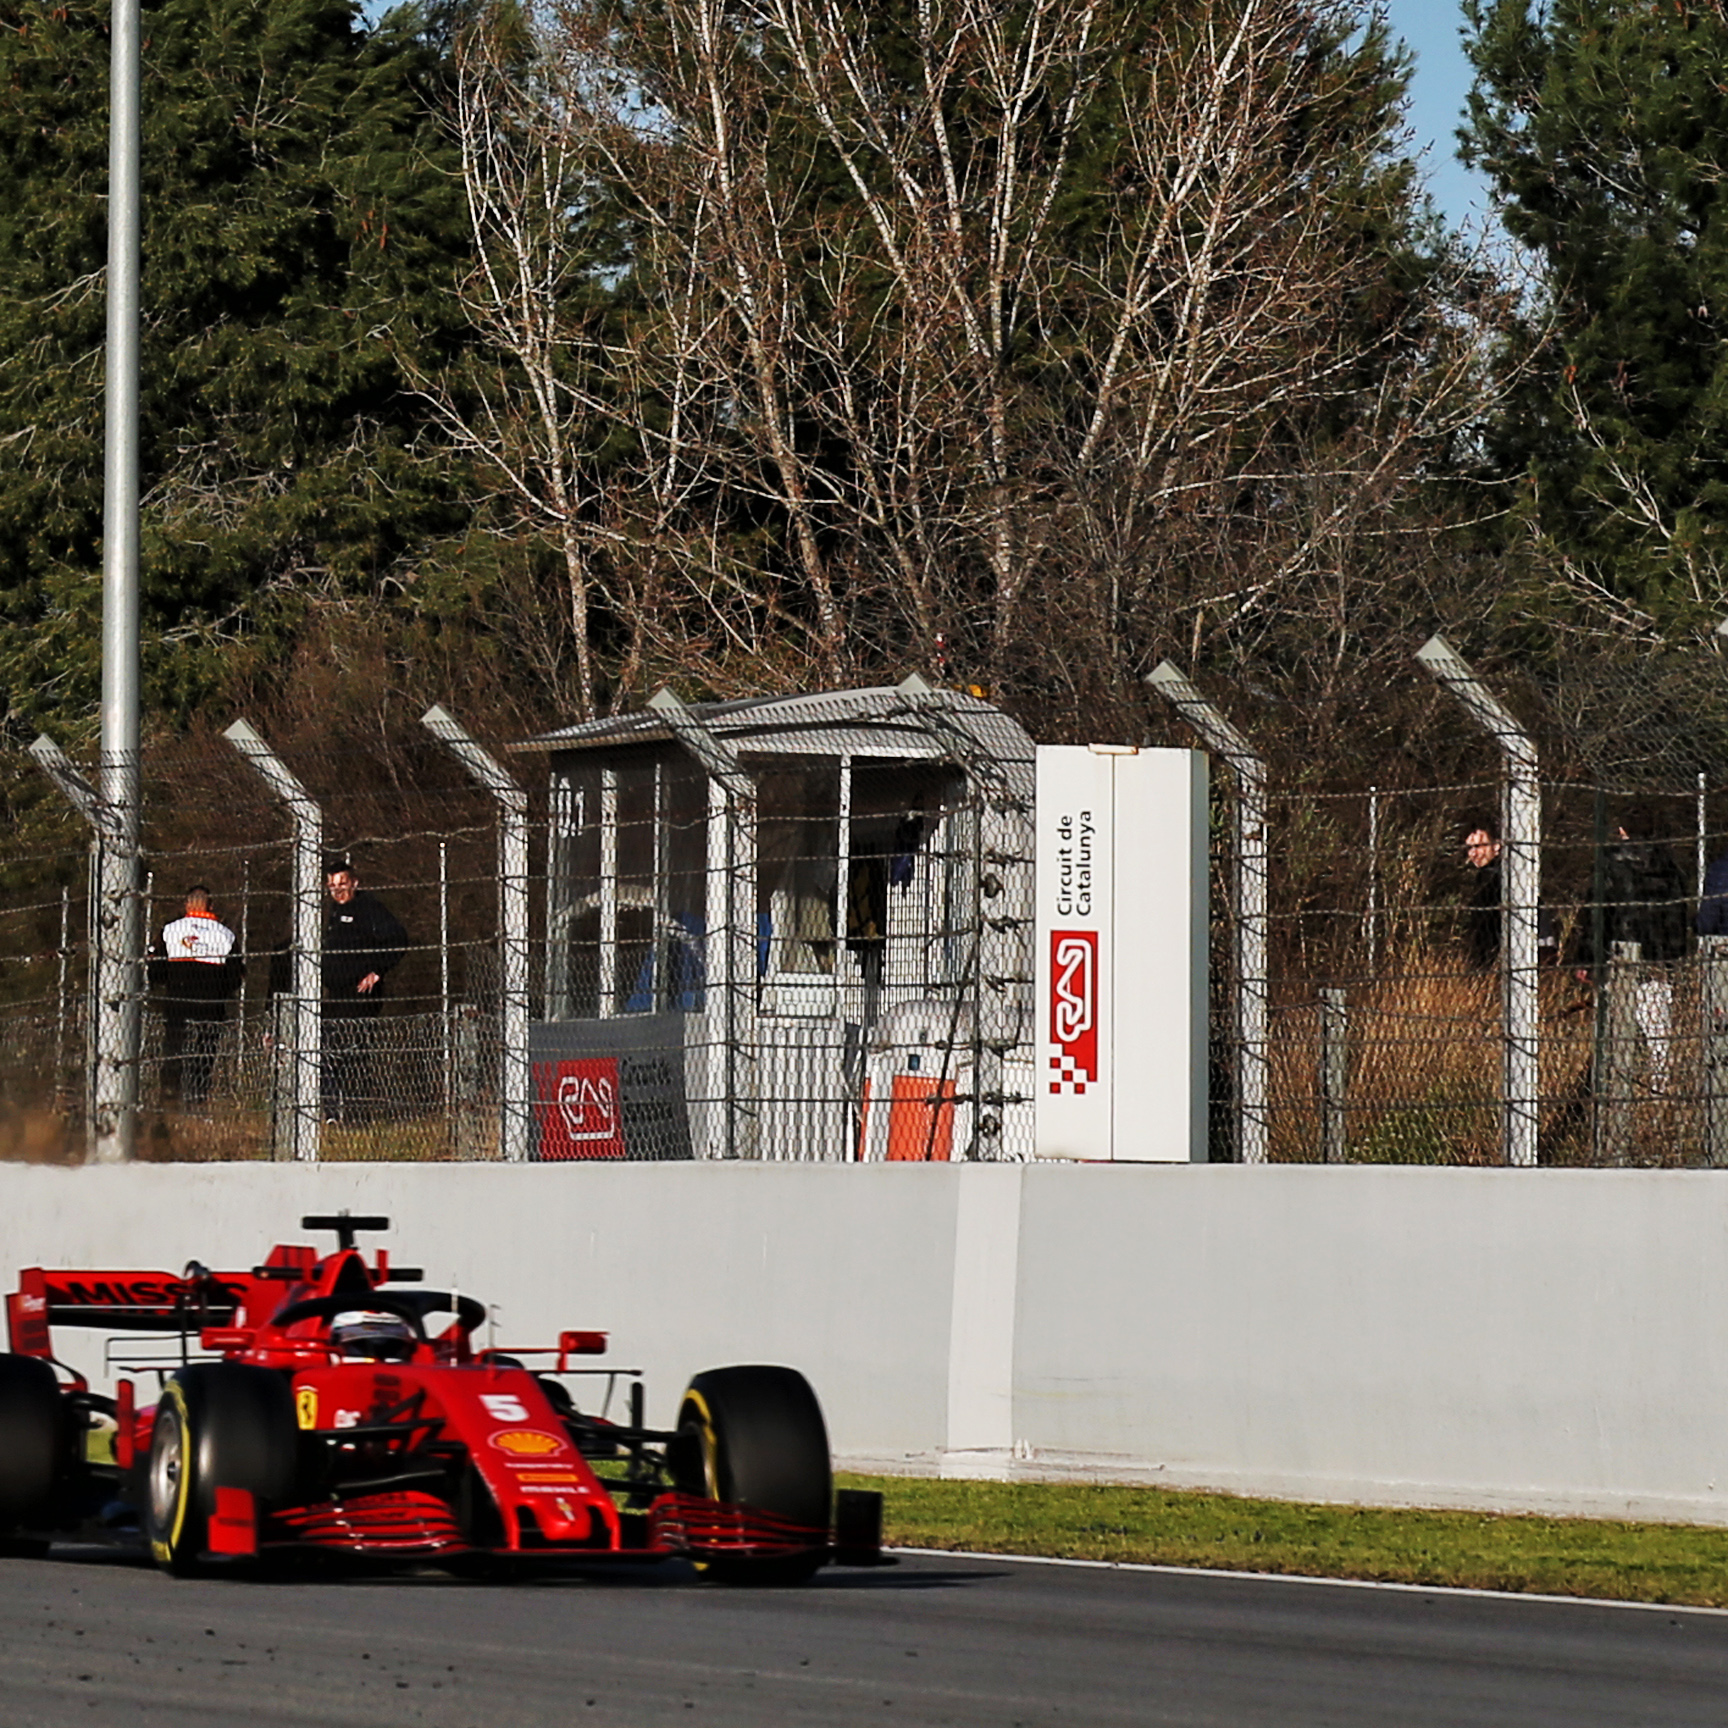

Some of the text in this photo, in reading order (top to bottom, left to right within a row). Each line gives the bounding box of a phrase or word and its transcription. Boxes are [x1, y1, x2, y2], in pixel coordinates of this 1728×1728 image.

[1056, 815, 1073, 916] Circuit de
[1076, 810, 1096, 916] Catalunya
[478, 1393, 531, 1422] 5
